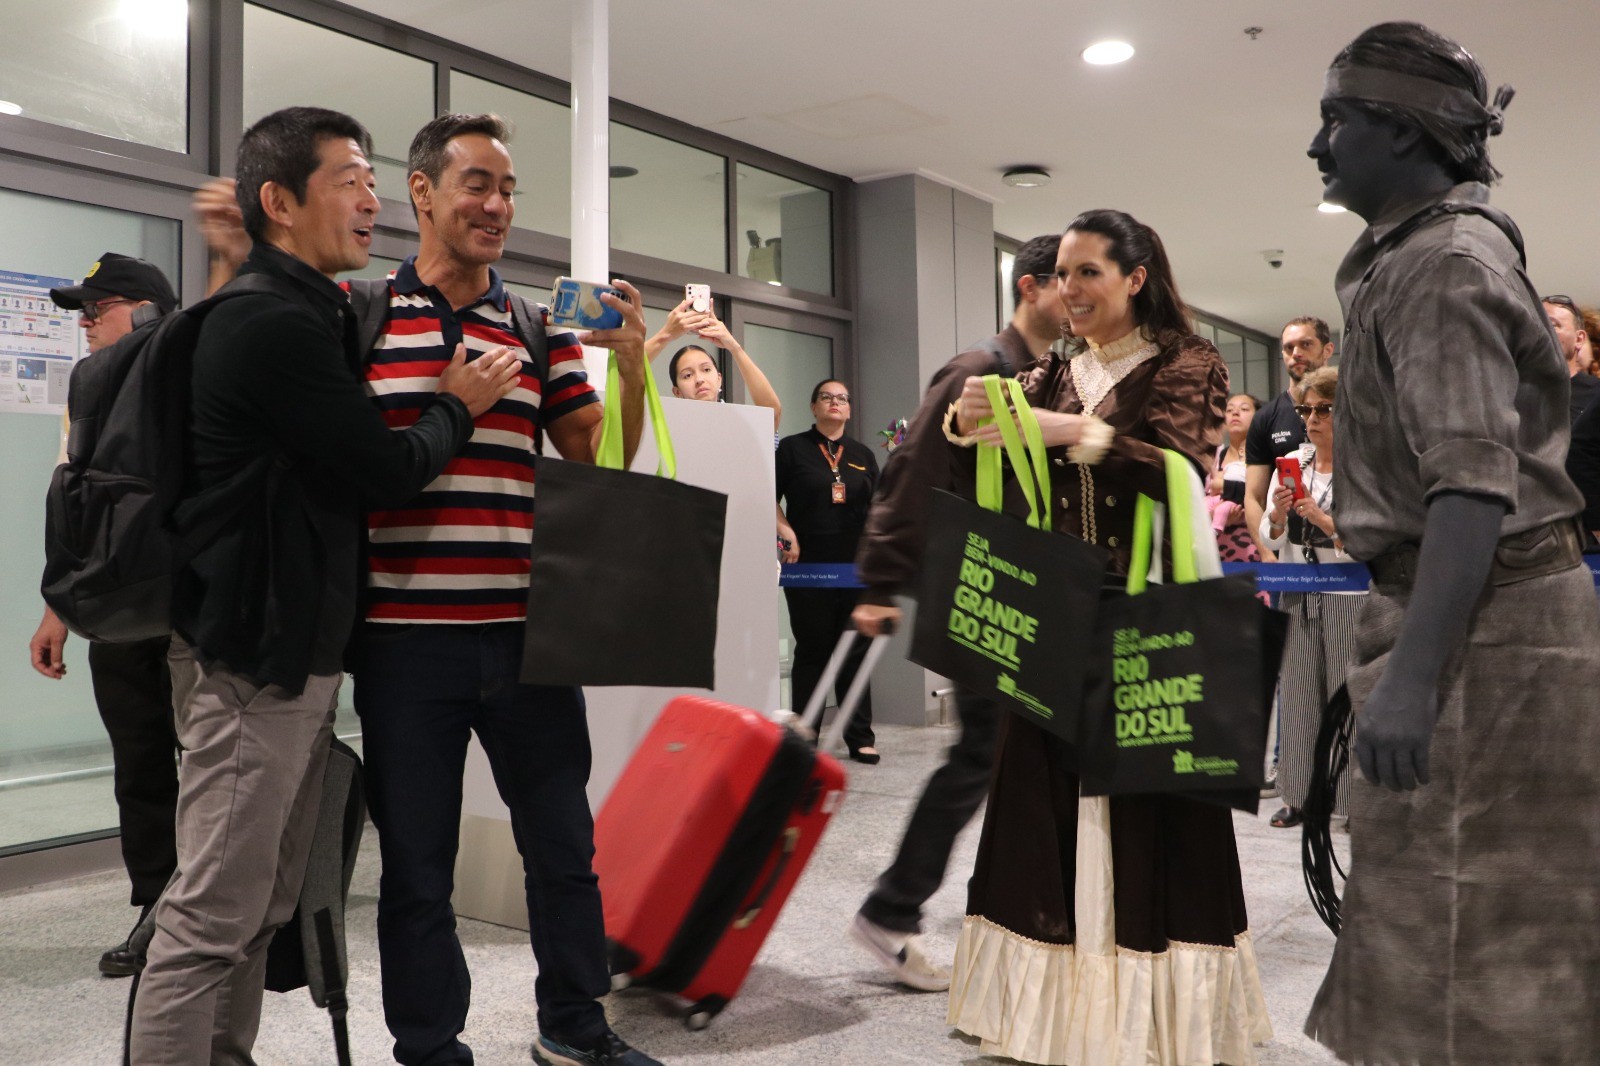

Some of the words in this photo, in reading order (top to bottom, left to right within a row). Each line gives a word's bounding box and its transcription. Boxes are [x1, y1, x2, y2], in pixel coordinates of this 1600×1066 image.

[967, 531, 989, 554] SEJA
[959, 557, 995, 593] RIO
[1019, 569, 1038, 587] AO
[953, 583, 1040, 644] GRANDE
[947, 607, 982, 642] DO
[979, 624, 1021, 665] SUL
[1113, 627, 1140, 644] SEJA
[1174, 631, 1194, 647] AO
[1113, 654, 1149, 683] RIO
[1114, 673, 1204, 711] GRANDE
[1115, 711, 1147, 739] DO
[1147, 705, 1192, 735] SUL
